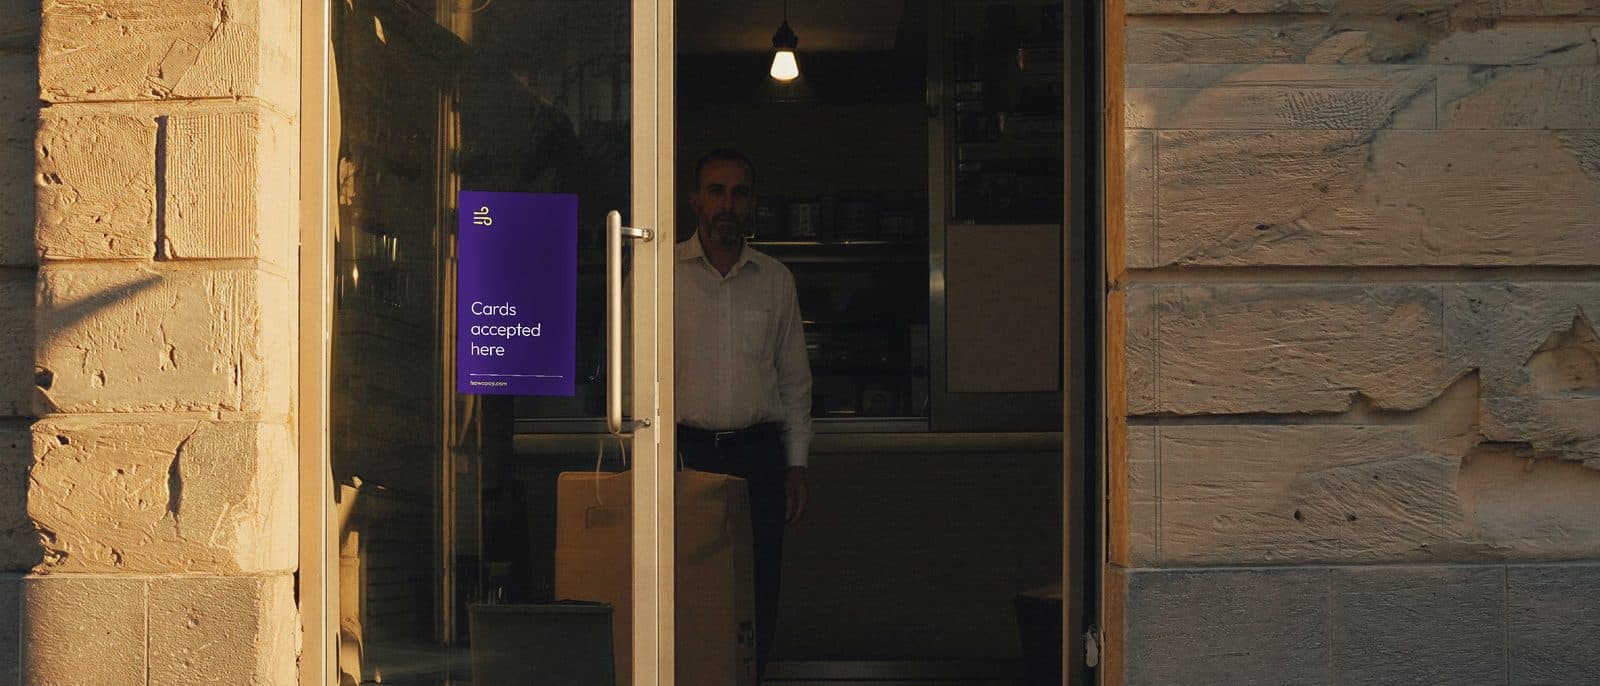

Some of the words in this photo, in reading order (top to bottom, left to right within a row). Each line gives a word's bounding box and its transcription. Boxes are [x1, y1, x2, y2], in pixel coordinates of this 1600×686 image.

[471, 302, 517, 316] Cards
[471, 323, 541, 339] accepted
[471, 342, 505, 356] here
